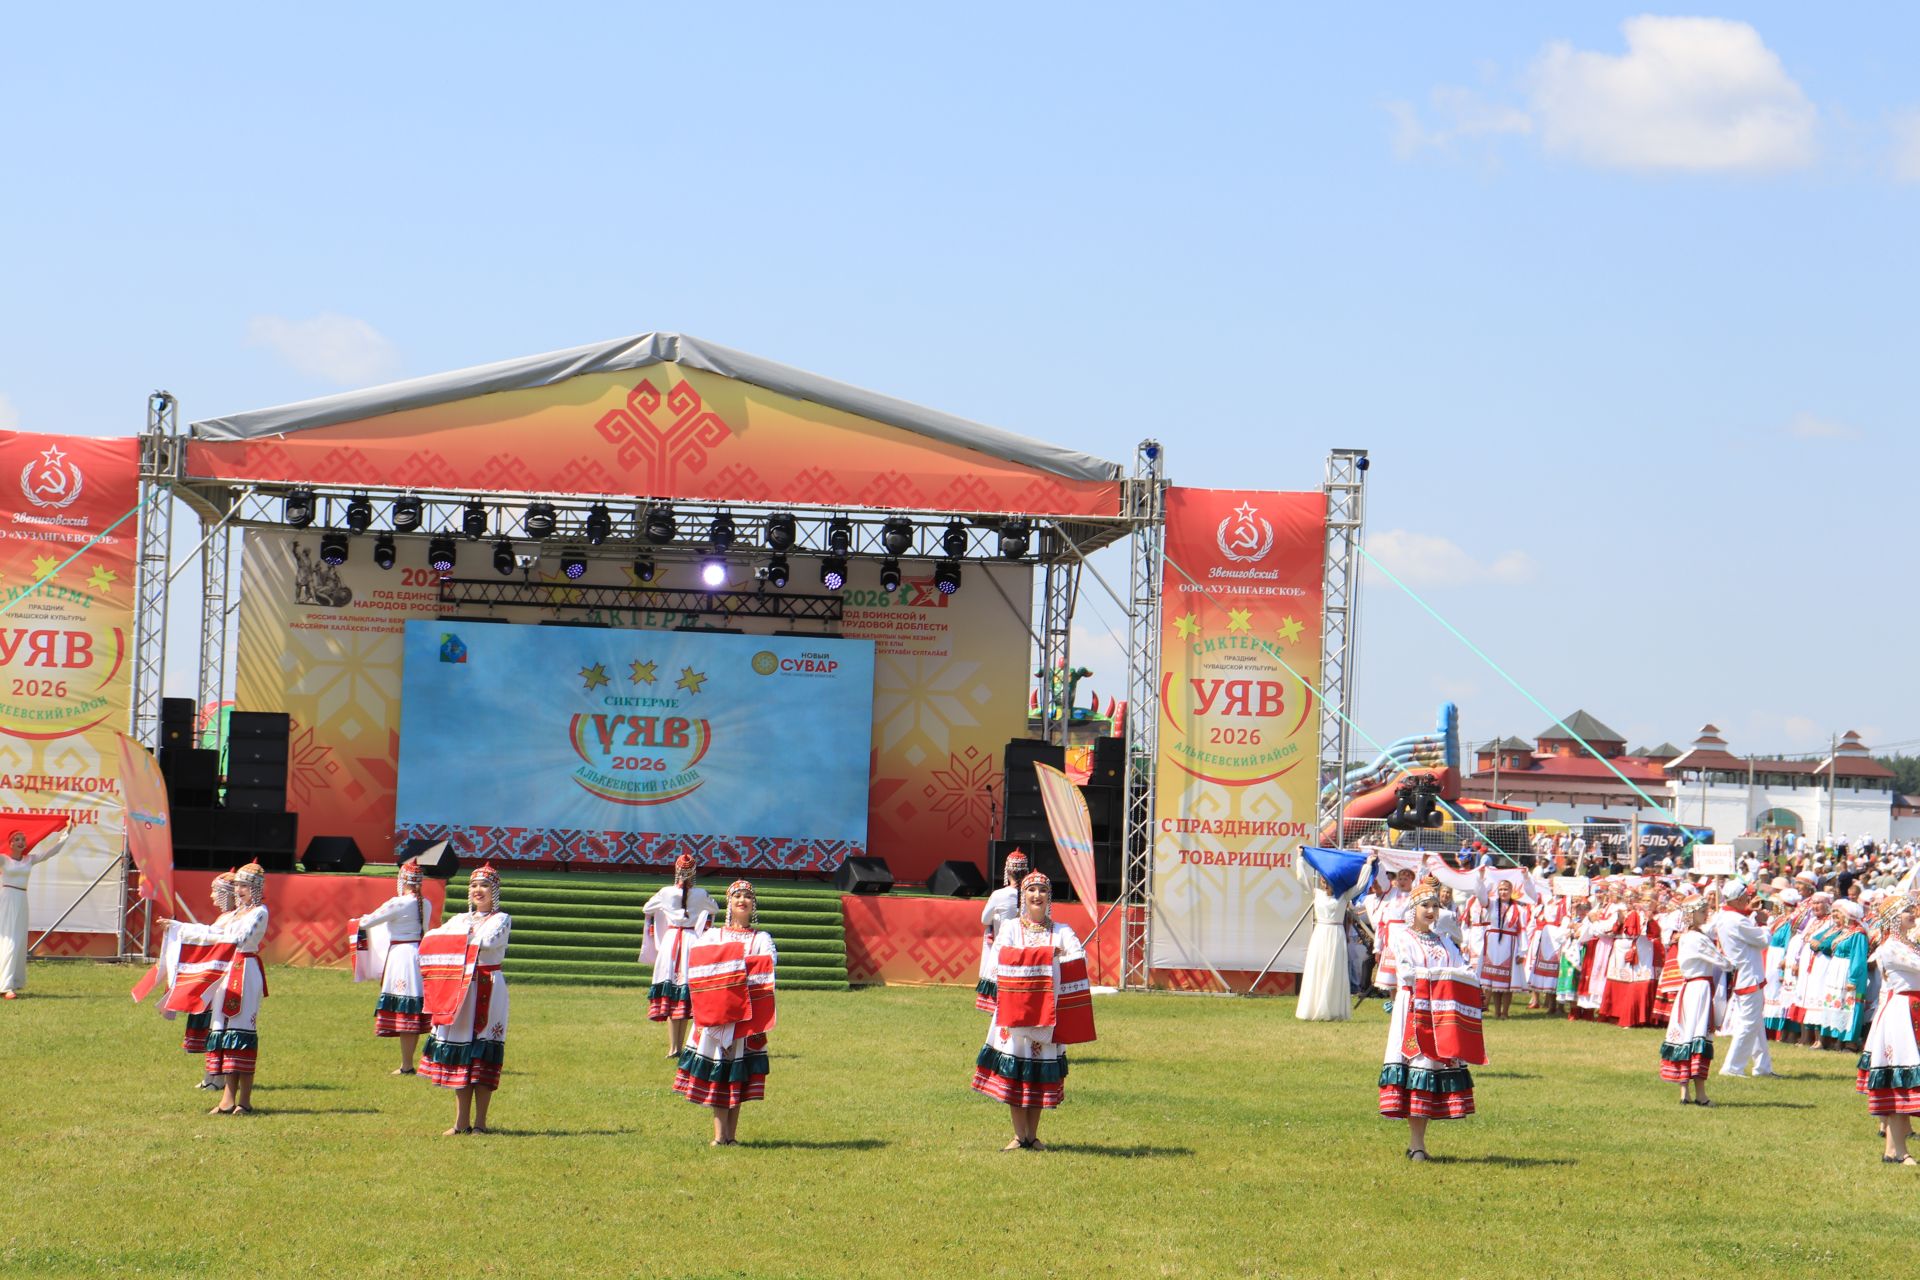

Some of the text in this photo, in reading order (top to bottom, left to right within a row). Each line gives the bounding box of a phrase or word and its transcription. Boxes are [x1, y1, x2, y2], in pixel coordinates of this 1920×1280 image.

[12, 512, 88, 526] Звениговский
[1208, 567, 1279, 580] Звениговский
[373, 591, 452, 601] ГОД ЕДИНСТ
[1179, 584, 1305, 596] ООО «ХУЗАНГАЕВСКОЕ»
[354, 601, 455, 612] НАРОДОВ РОССИИ
[842, 590, 890, 607] 2026
[6, 612, 49, 620] ЧУВАШСКОЙ
[842, 610, 926, 621] ГОД ВОИНСКОЙ И
[842, 620, 948, 631] ТРУДОВОЙ ДОБЛЕСТИ
[0, 628, 94, 669] УЯВ
[1193, 636, 1284, 659] СИКТЕРМЕ
[780, 659, 838, 673] СУВАР
[12, 679, 67, 698] 2026
[604, 696, 679, 708] СИКТЕРМЕ
[1190, 678, 1285, 717] УЯВ
[66, 695, 108, 717] РАЙОН
[1211, 728, 1261, 745] 2026
[1174, 742, 1298, 767] АЛЬКЕЕВСКИЙ РАЙОН
[612, 756, 667, 771] 2026
[576, 766, 700, 792] АЛЬКЕЕВСКИЙ РАЙОН
[1162, 818, 1311, 840] С ПРАЗДНИКОМ,
[1179, 850, 1292, 870] ТОВАРИЩИ!
